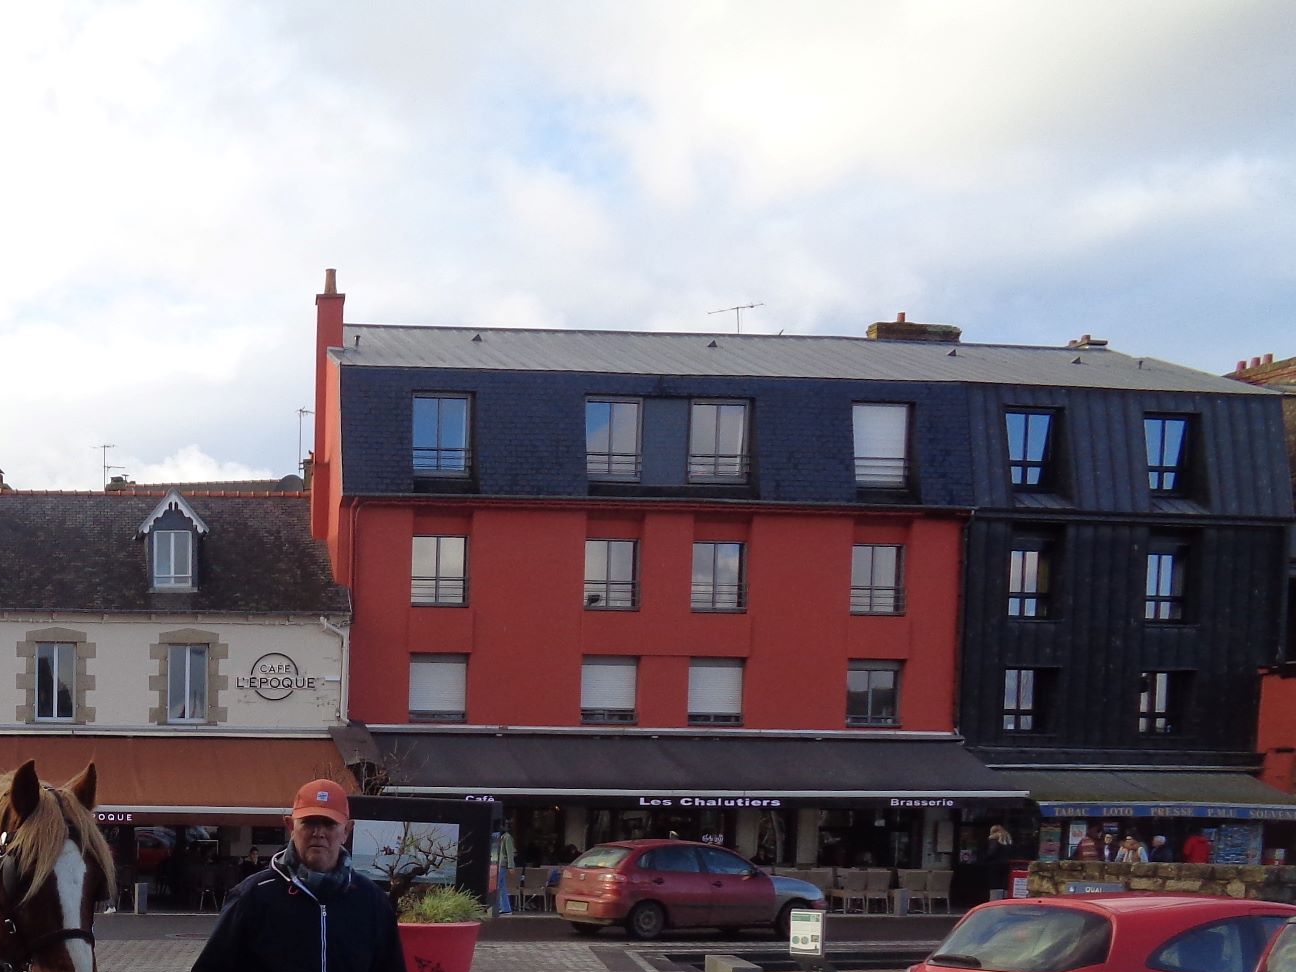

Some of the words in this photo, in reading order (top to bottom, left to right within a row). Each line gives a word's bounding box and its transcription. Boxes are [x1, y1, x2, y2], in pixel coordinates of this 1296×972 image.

[639, 797, 673, 806] Les
[680, 797, 782, 807] Chalutiers
[890, 798, 954, 807] Brasserie
[1054, 807, 1090, 817] TABAC
[1102, 807, 1134, 817] LOTO
[1150, 807, 1194, 817] PRESSE
